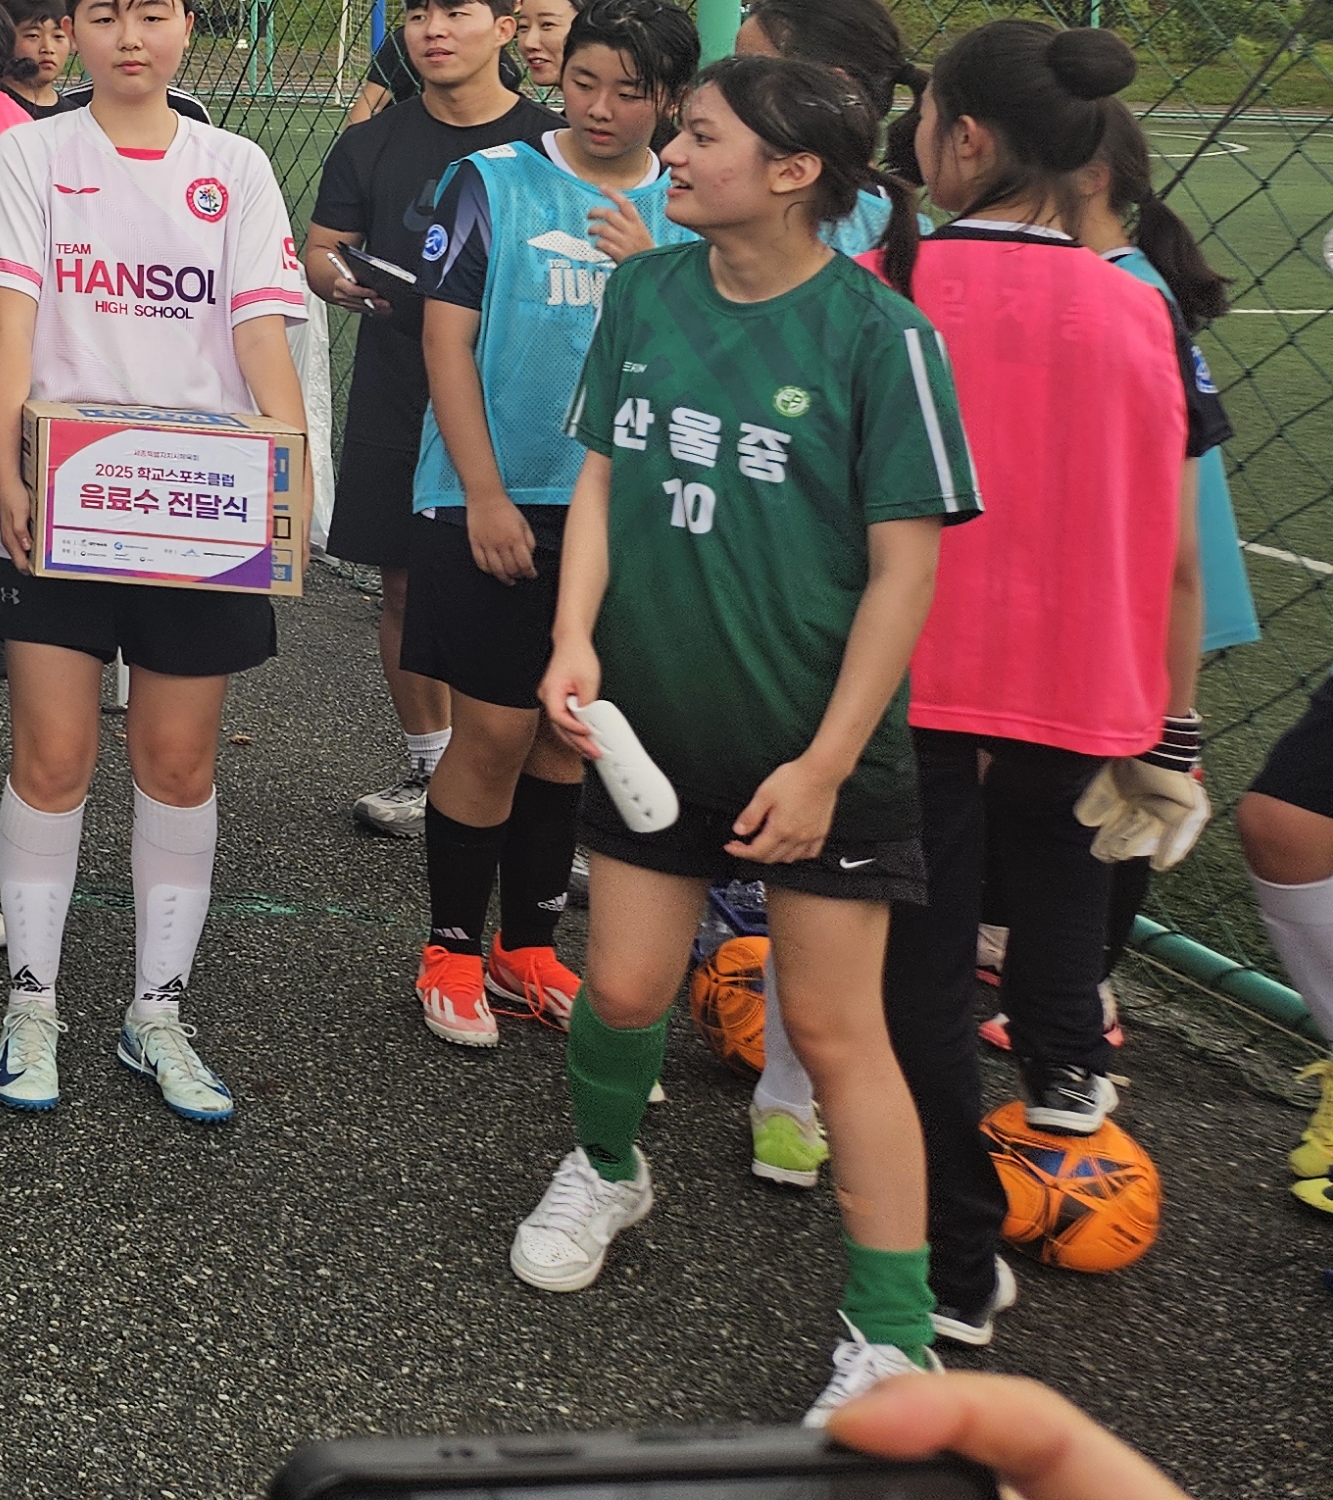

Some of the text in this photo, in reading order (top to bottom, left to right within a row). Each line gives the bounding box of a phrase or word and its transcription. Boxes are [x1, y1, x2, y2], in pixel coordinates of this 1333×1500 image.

[56, 243, 92, 255] TEAM
[56, 259, 216, 305] HANSOL
[95, 301, 194, 320] HIGH SCHOOL
[613, 397, 792, 483] 산울중
[95, 463, 235, 488] 2025 학교스포츠클럽
[79, 483, 248, 523] 음료수 전달식
[662, 478, 716, 534] 10
